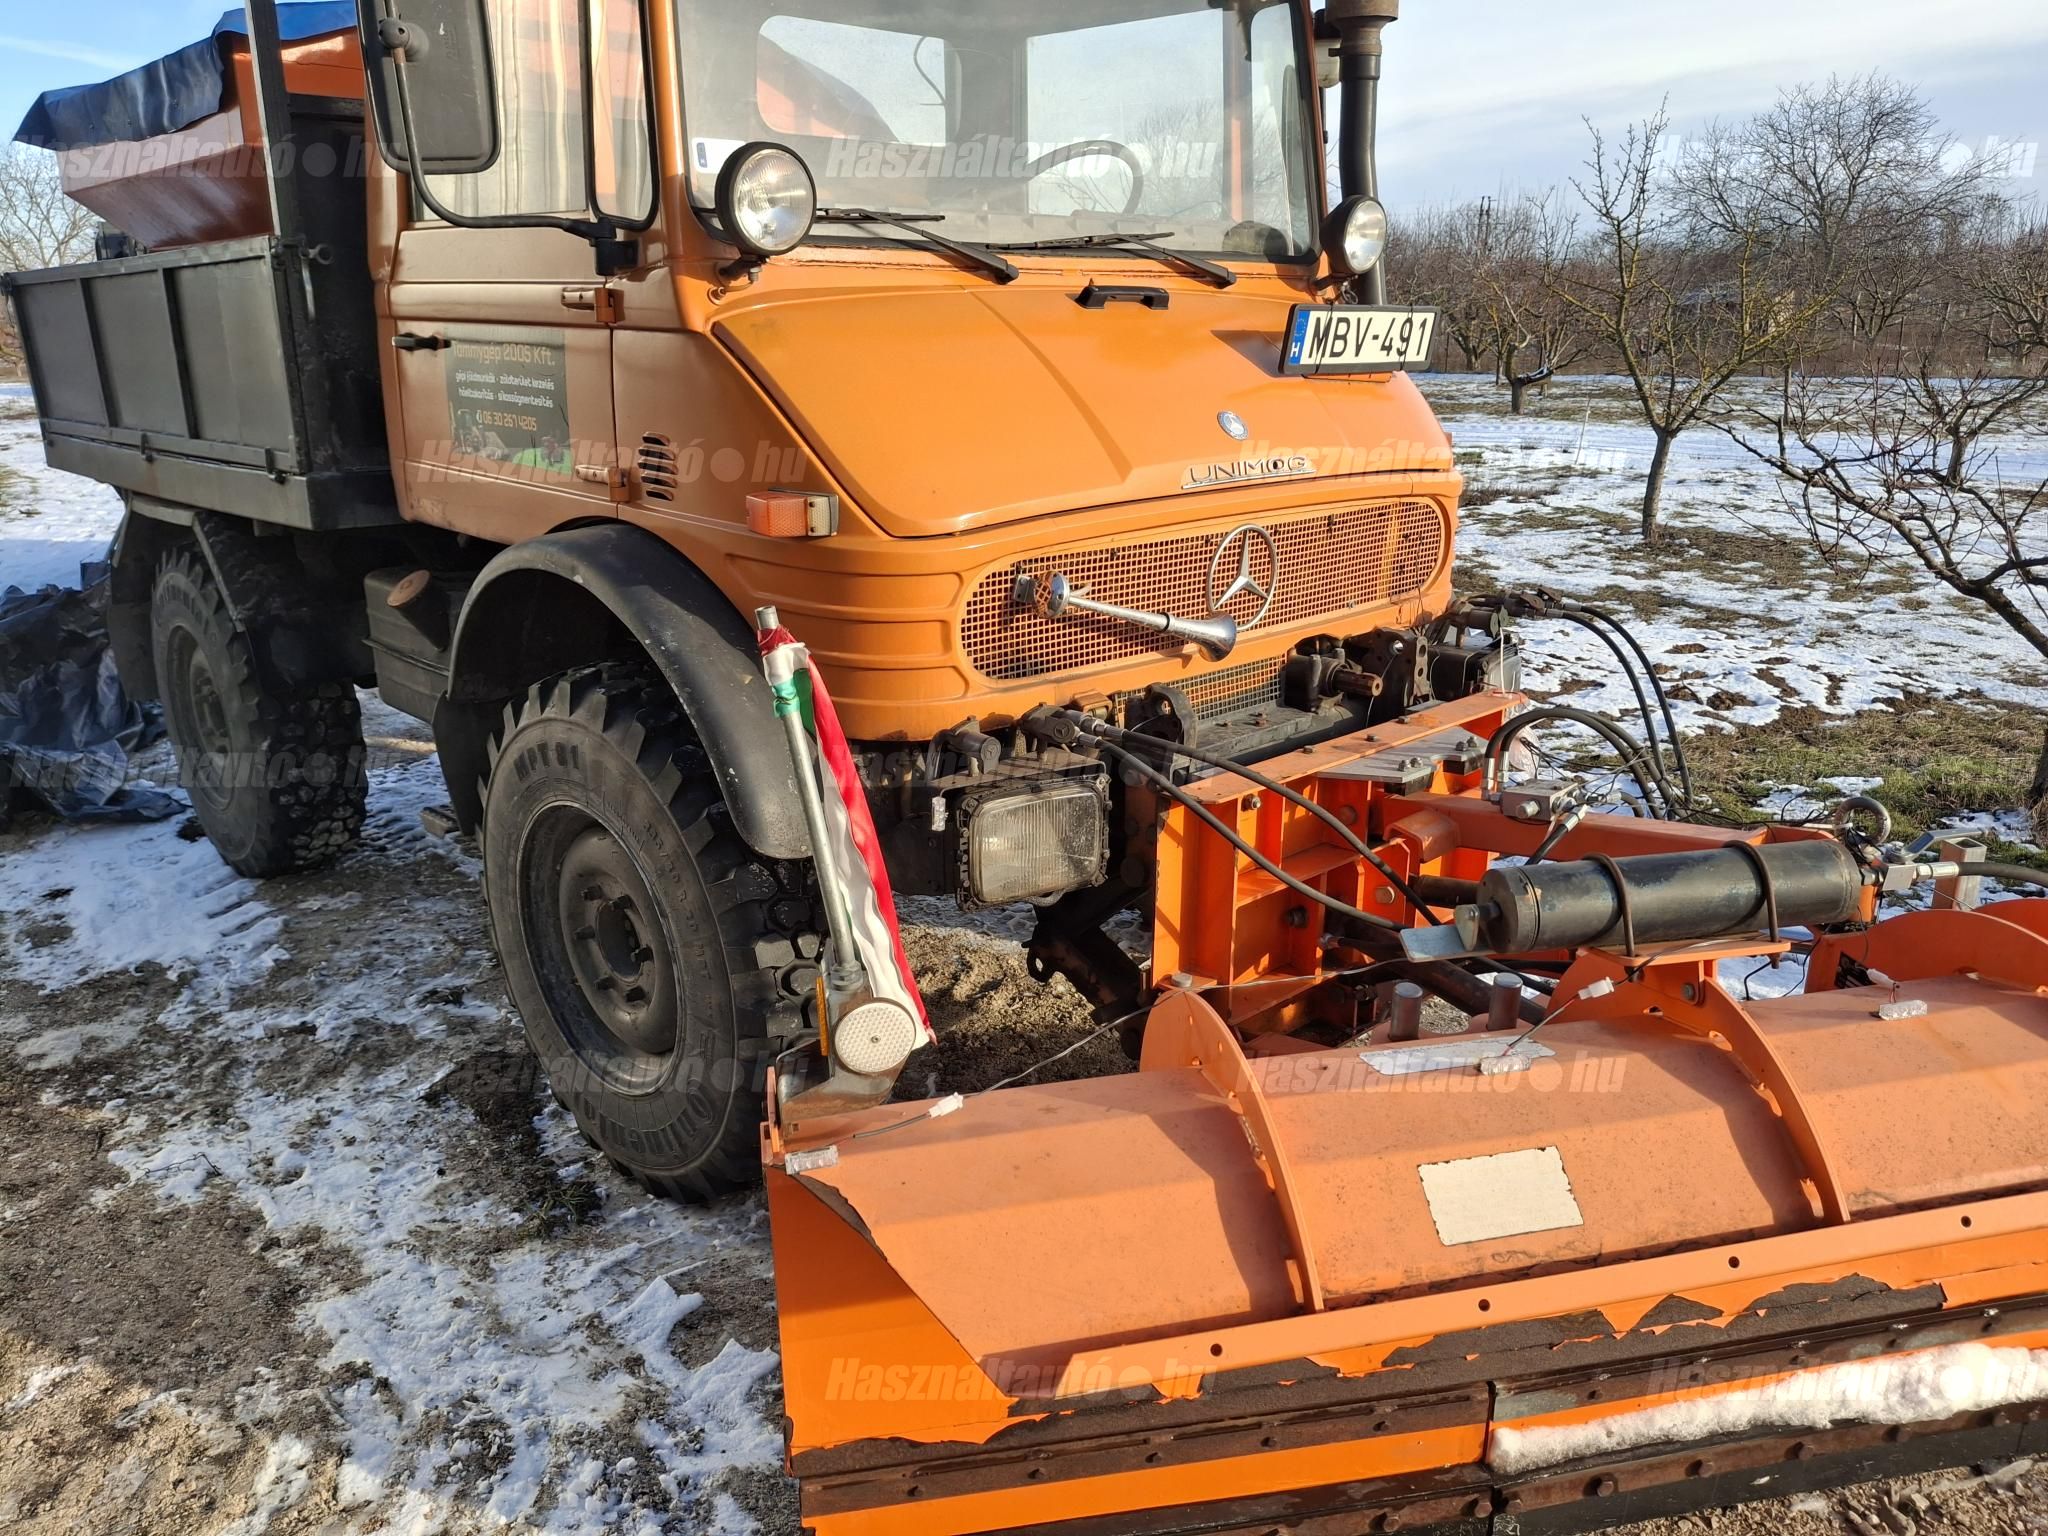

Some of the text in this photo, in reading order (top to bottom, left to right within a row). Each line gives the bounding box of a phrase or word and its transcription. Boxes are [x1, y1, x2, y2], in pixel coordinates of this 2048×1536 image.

[1290, 342, 1300, 357] H
[1308, 316, 1427, 358] MBV-491
[503, 343, 531, 363] 2005
[533, 345, 556, 366] Kft.
[1190, 456, 1305, 483] UNIMOG
